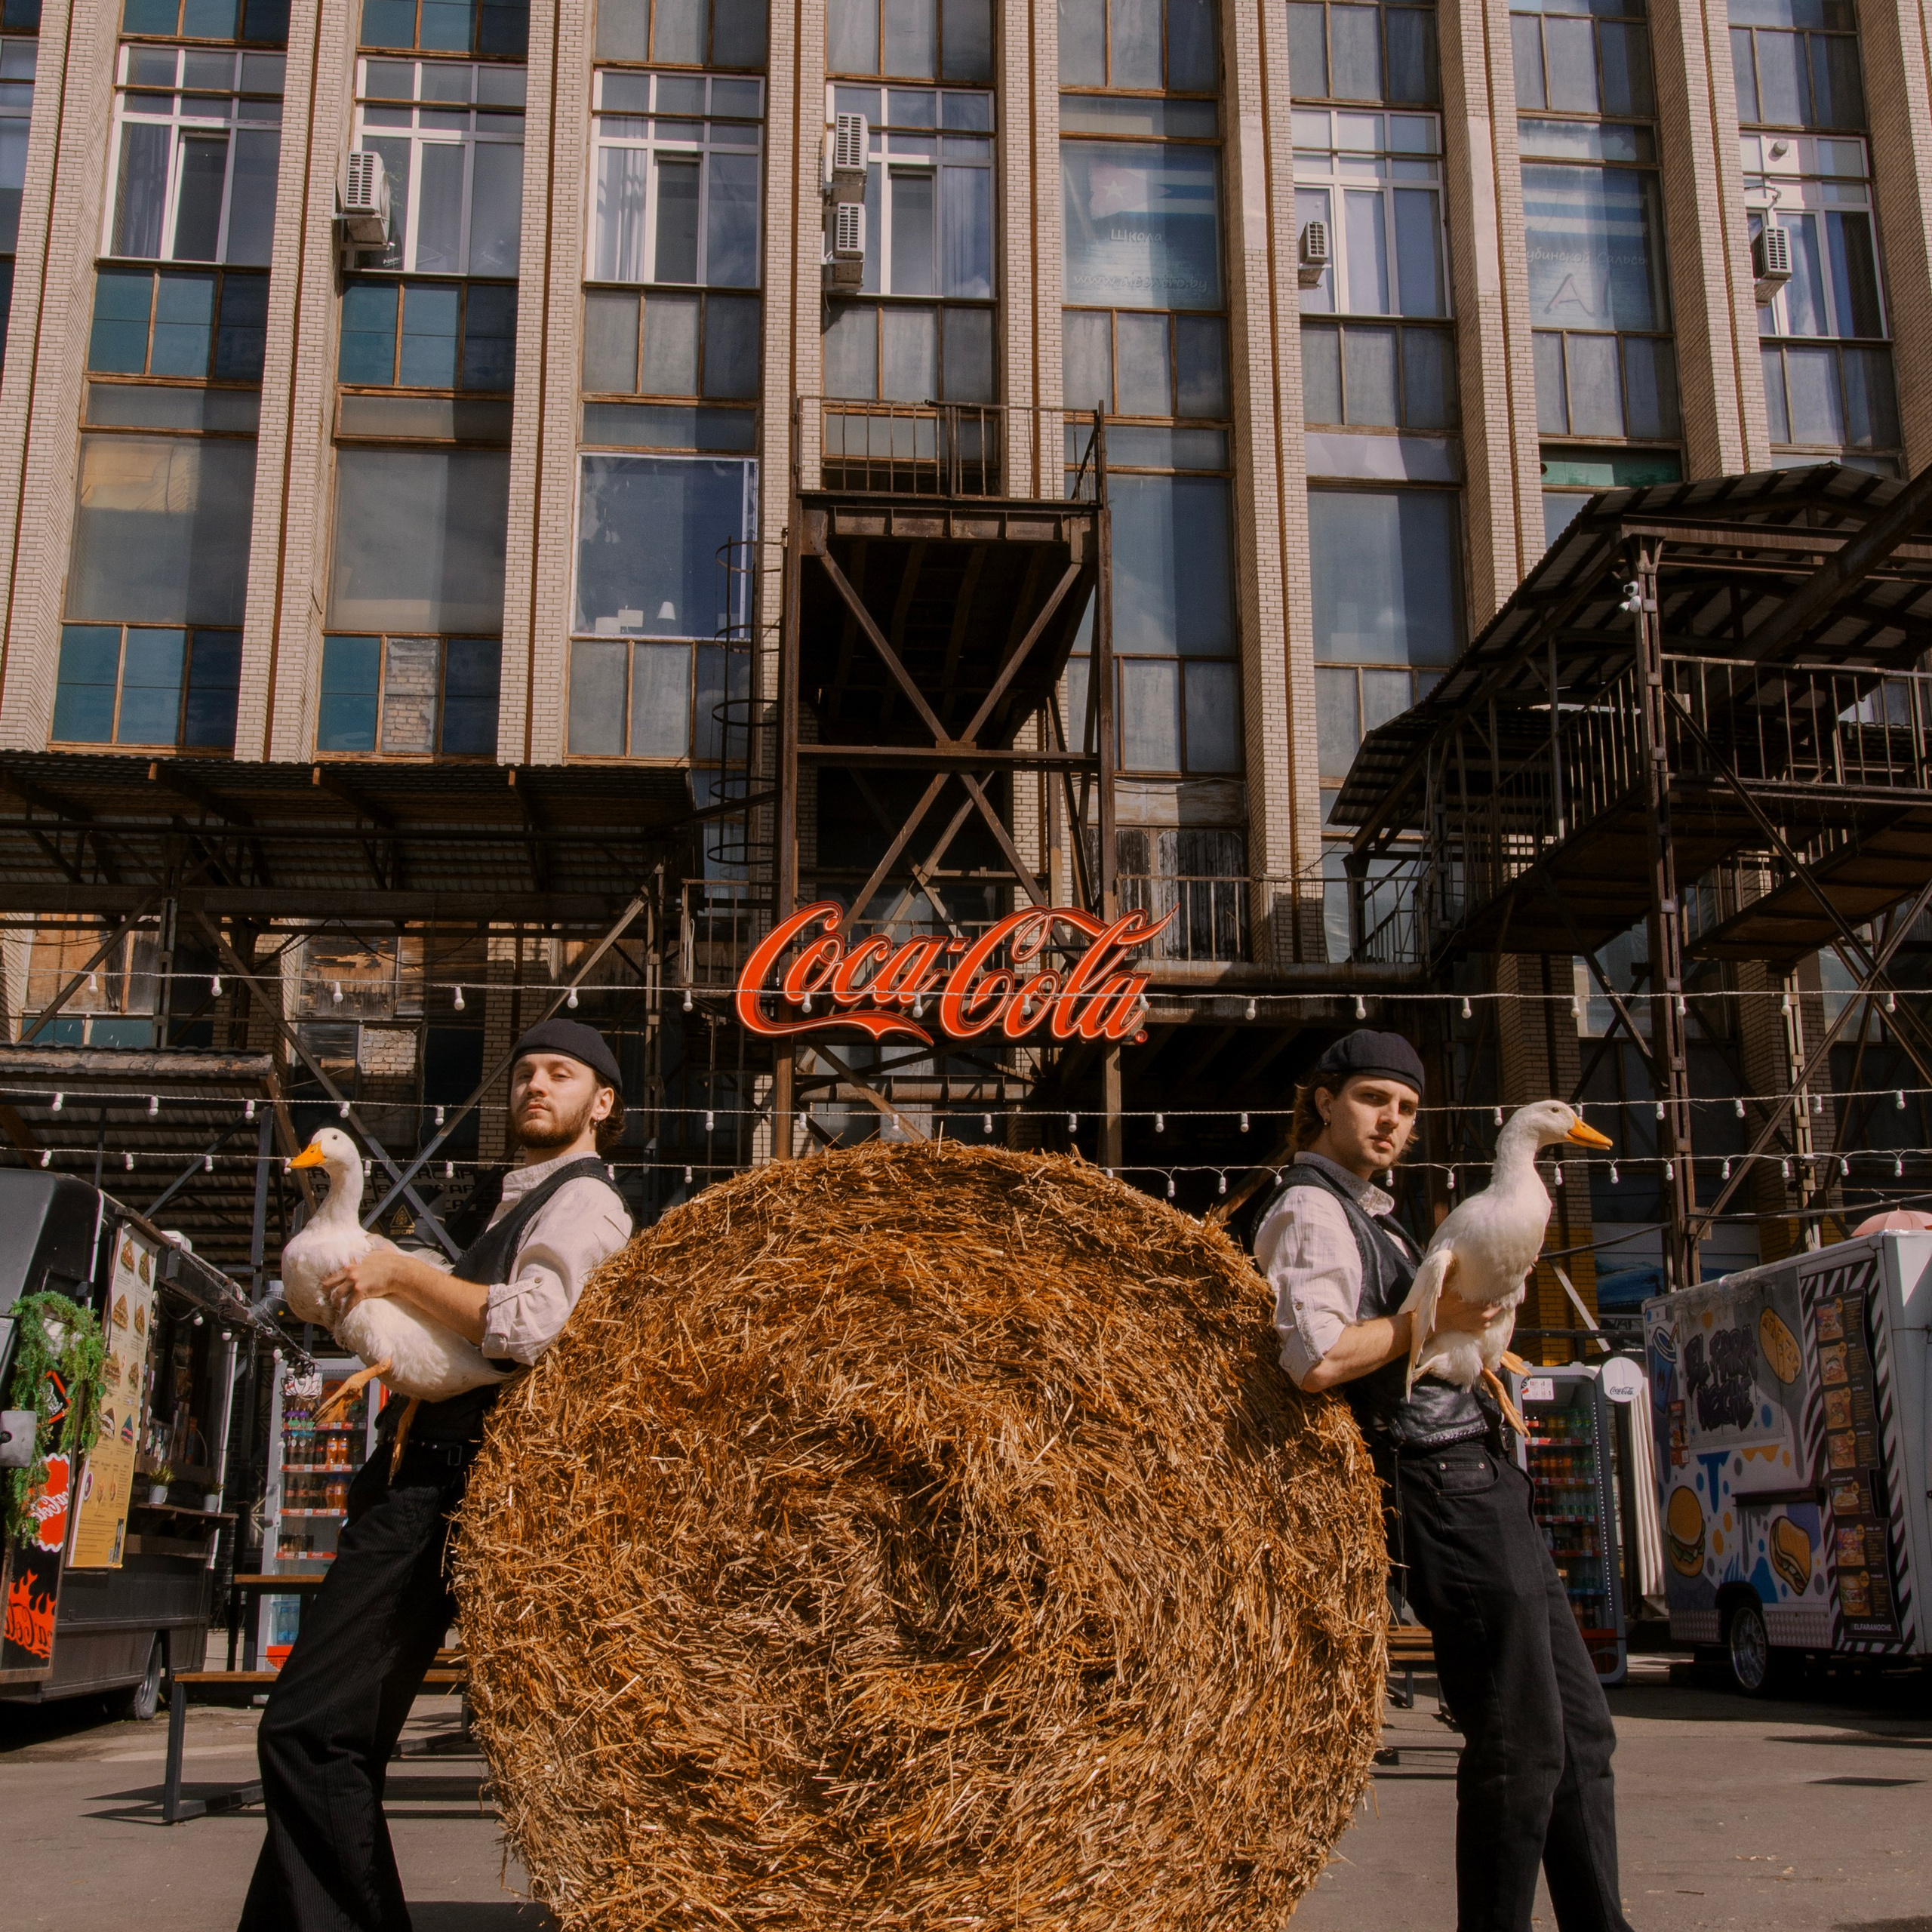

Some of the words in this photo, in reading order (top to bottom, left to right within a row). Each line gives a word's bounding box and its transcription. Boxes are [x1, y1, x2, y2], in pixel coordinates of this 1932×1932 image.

[1110, 228, 1163, 243] Школа
[1526, 247, 1590, 263] убинской
[736, 900, 1180, 1047] Coca-Cola
[1609, 1386, 1635, 1395] Coca-Cola
